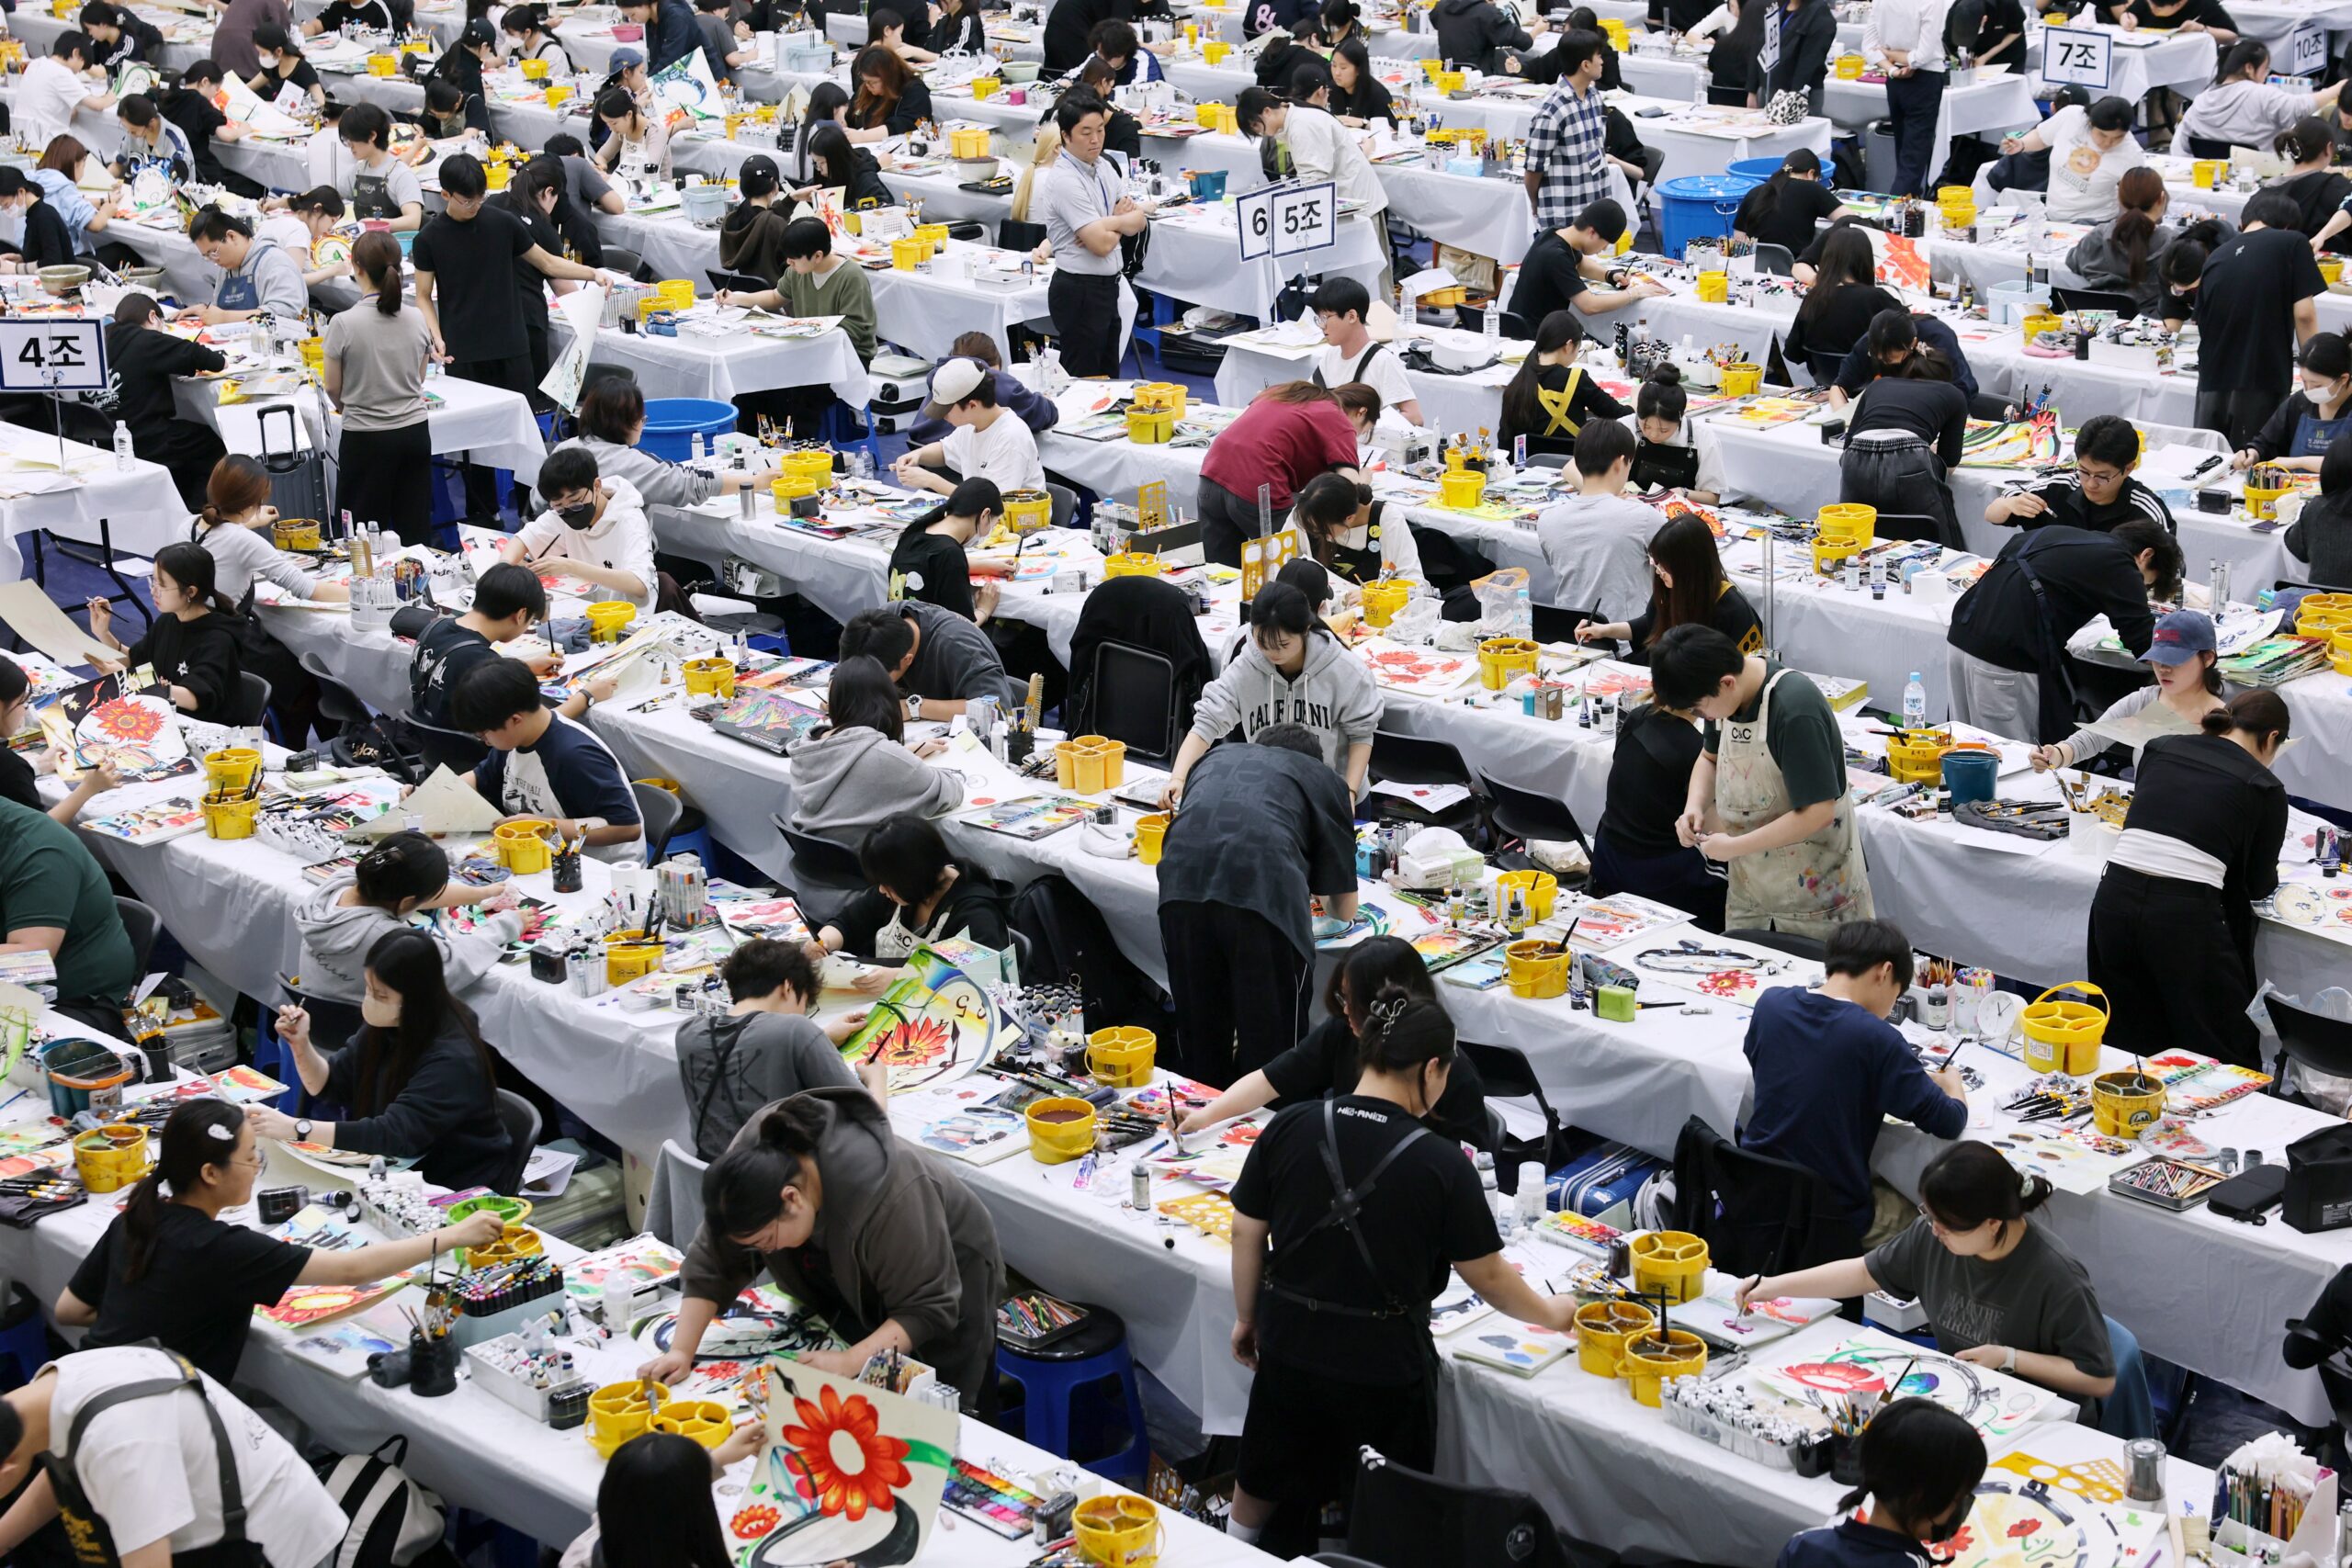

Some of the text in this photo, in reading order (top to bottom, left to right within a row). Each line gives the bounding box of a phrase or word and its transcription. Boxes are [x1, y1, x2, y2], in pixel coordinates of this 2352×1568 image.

[2059, 42, 2097, 70] 7조
[2296, 32, 2323, 61] 10조
[1284, 199, 1323, 234] 5조
[18, 335, 85, 367] 4조
[1731, 727, 1752, 740] C&C
